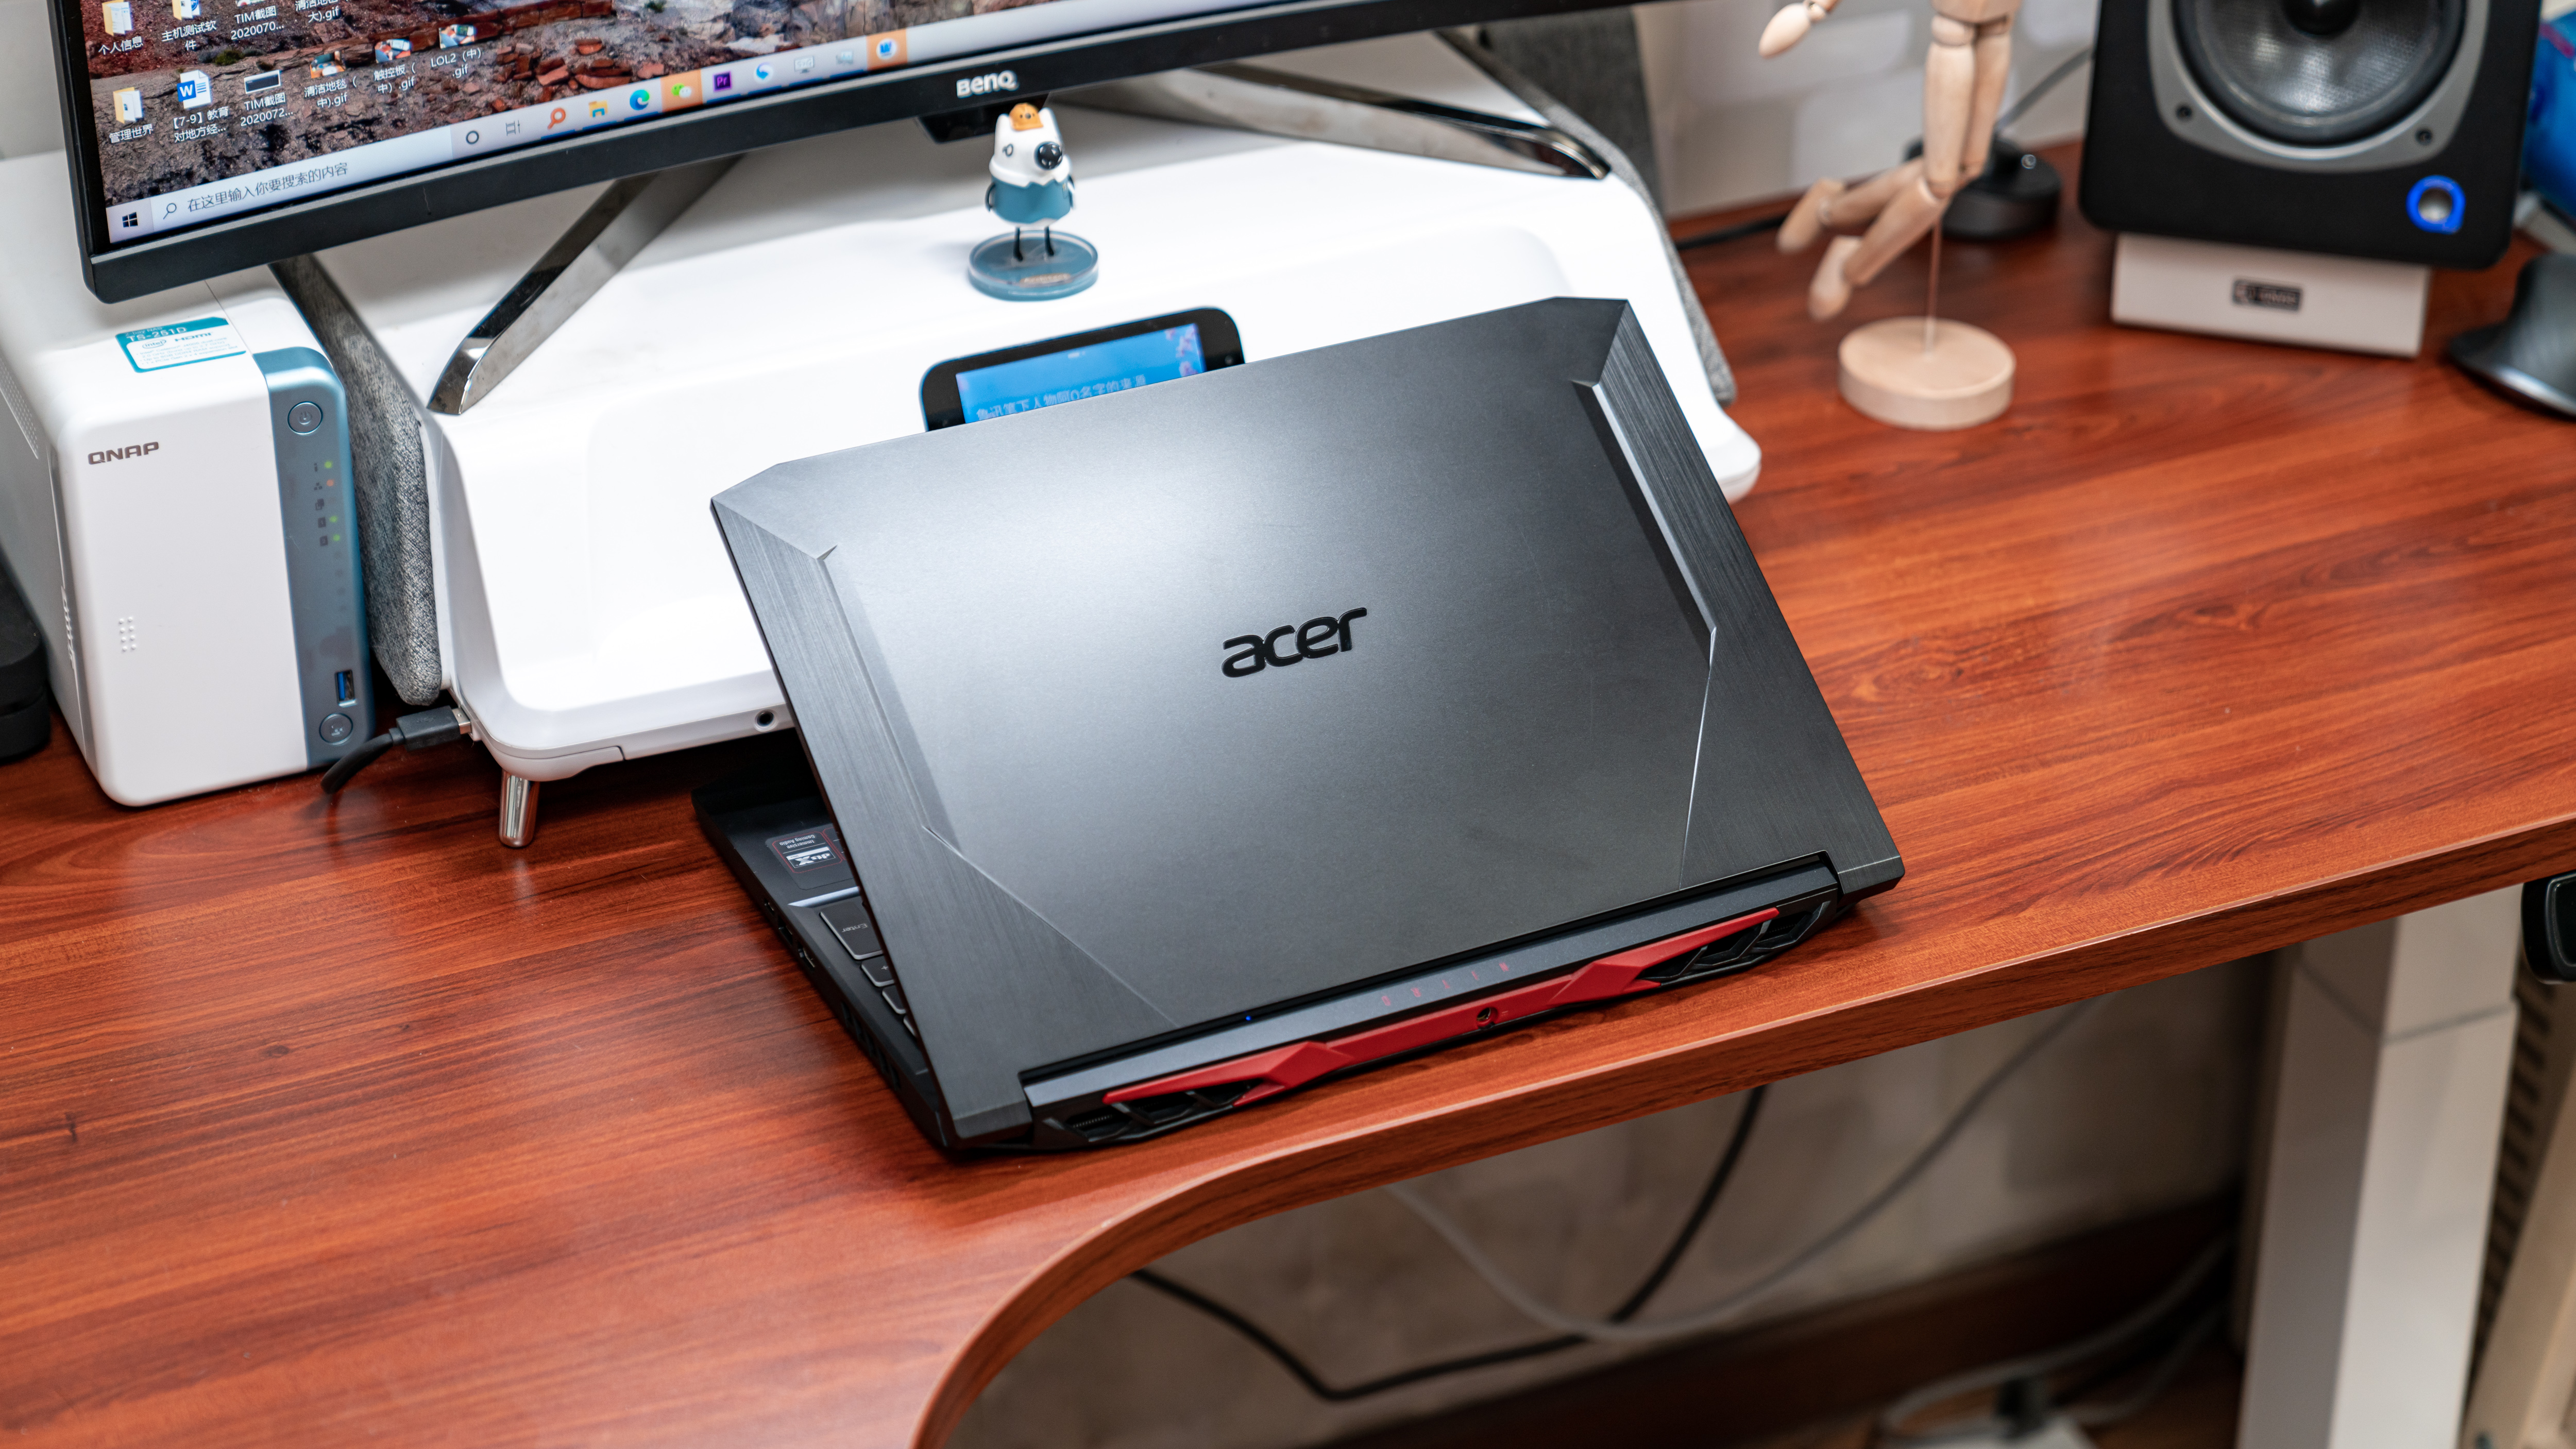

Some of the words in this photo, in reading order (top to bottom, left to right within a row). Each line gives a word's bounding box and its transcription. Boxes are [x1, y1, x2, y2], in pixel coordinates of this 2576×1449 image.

[234, 6, 277, 24] TIM截图
[161, 21, 217, 42] 主机测试软
[98, 36, 144, 55] 个人信息
[185, 40, 197, 51] 件
[452, 65, 469, 79] .gif
[717, 76, 727, 88] Pr
[956, 70, 1020, 98] BenQ
[244, 92, 286, 111] TIM截图
[109, 124, 153, 143] 管理世界
[187, 162, 349, 213] 在这里输入你要搜索的内容
[127, 327, 188, 342] TS-251D
[88, 441, 160, 465] QNAP
[1222, 607, 1367, 677] acer
[779, 838, 794, 846] Audio
[786, 840, 815, 849] Immersive
[794, 834, 816, 842] Gaming
[841, 923, 868, 933] Enter
